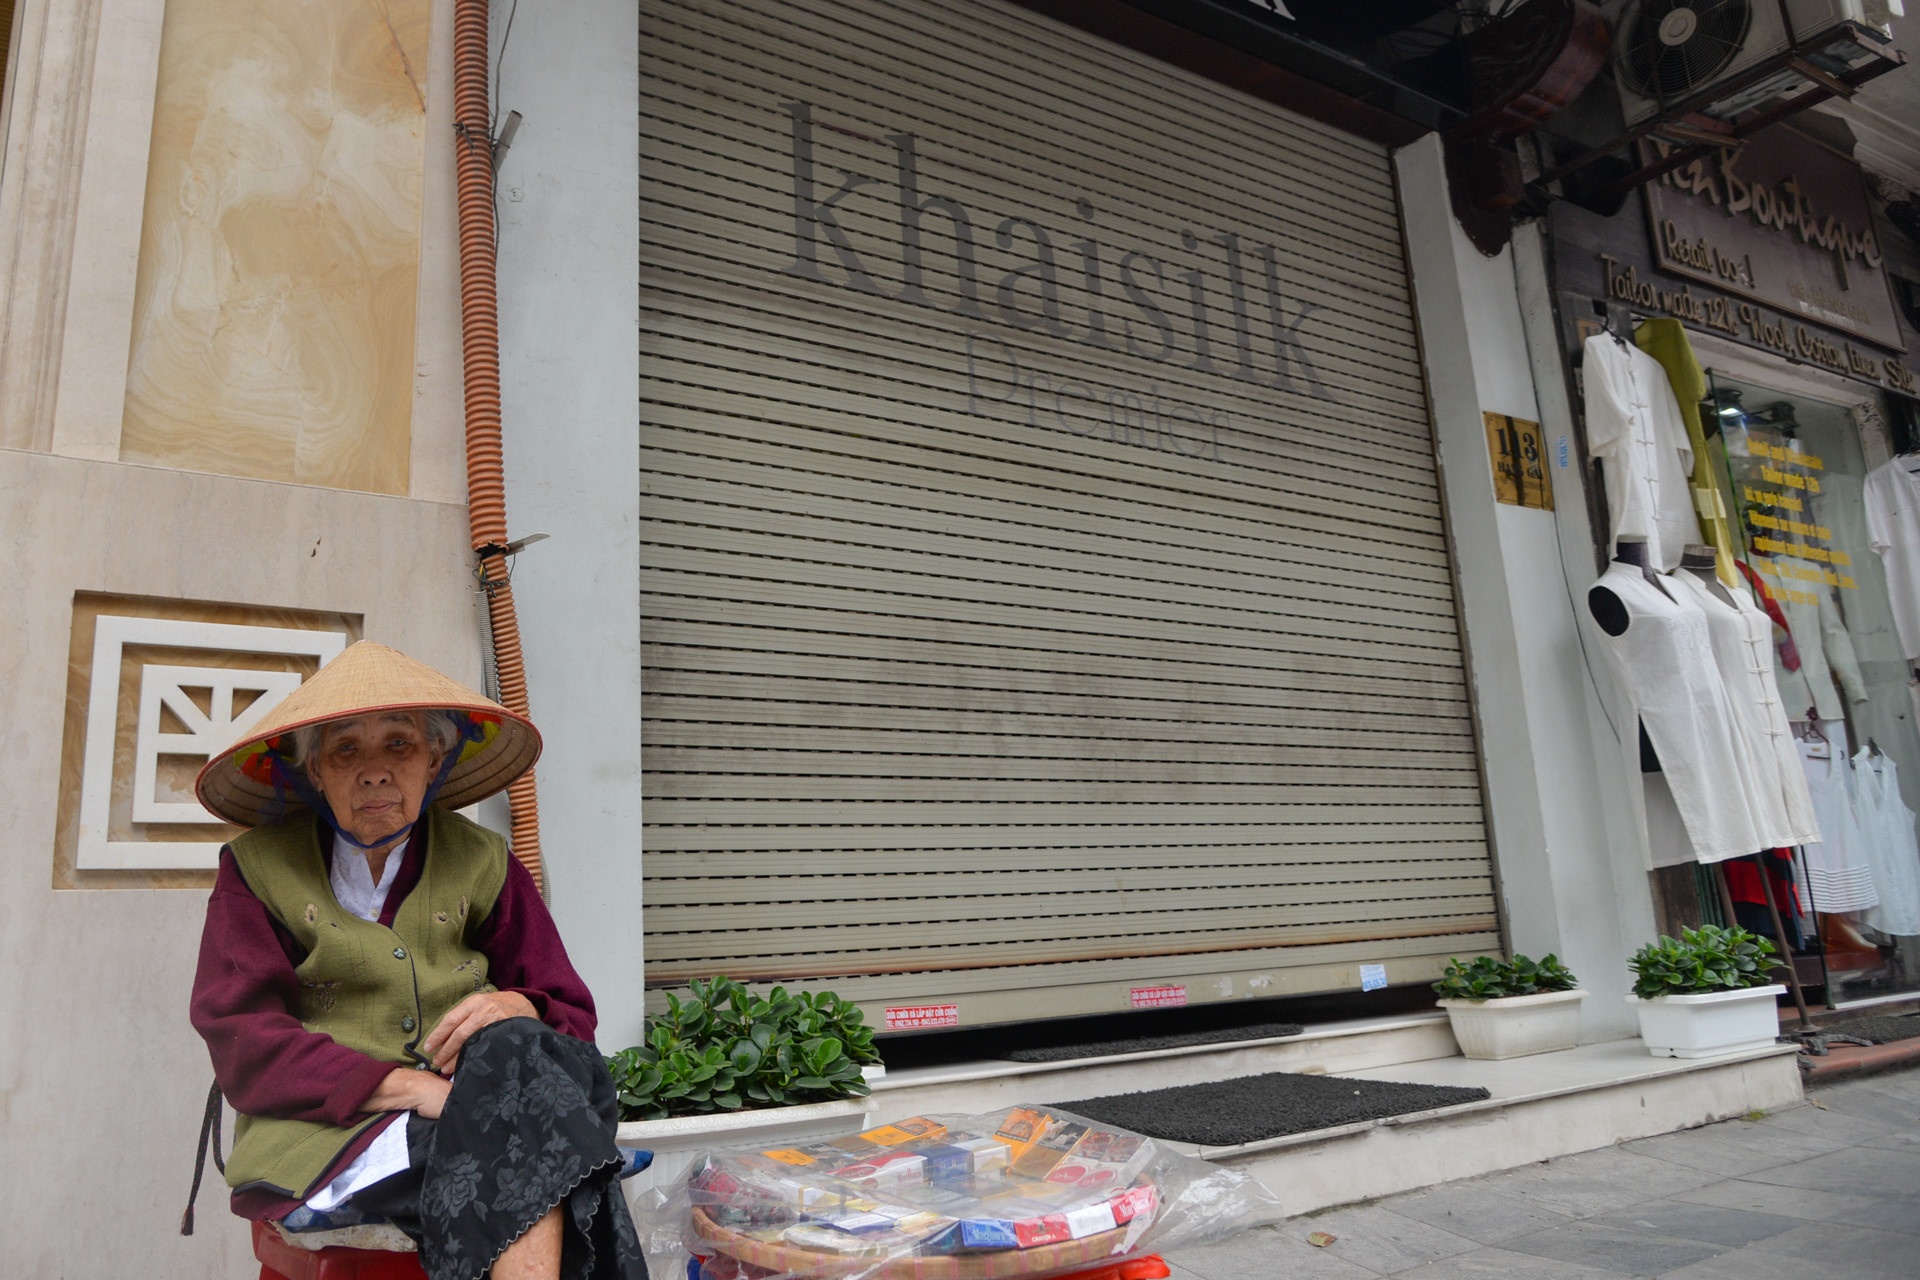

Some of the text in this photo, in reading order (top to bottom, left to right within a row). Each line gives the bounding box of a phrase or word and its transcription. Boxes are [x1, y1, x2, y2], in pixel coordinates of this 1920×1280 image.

[777, 100, 1336, 401] khaisilk
[1662, 218, 1713, 271] Retail
[1599, 252, 1661, 309] Tailor
[1662, 283, 1704, 322] made
[1739, 303, 1795, 356] Wool,
[962, 327, 1231, 460] Premier
[1495, 428, 1538, 461] 113
[1119, 1195, 1150, 1217] Marlboro
